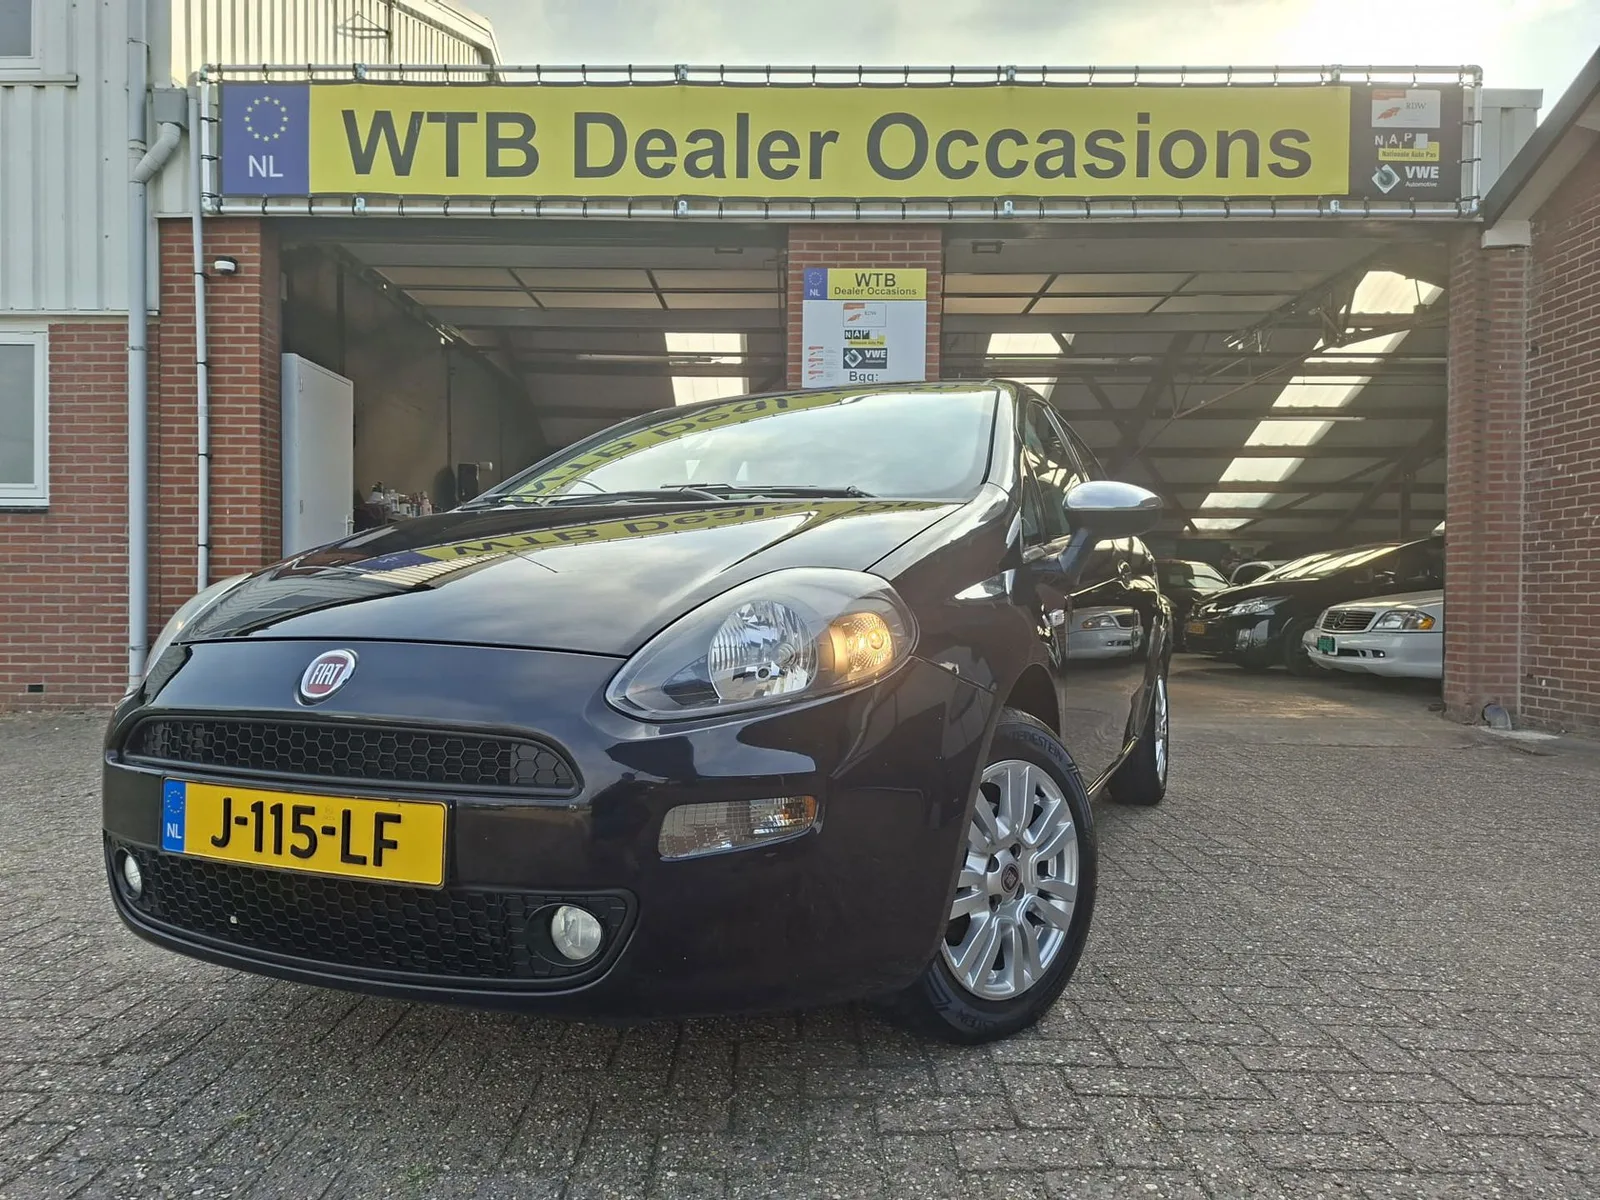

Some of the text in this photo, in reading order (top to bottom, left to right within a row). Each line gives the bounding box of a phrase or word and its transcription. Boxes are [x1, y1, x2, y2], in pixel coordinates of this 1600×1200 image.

[341, 109, 1313, 181] WTB Dealer Occasions
[1381, 150, 1437, 158] Nationale Auto Pas
[247, 154, 284, 179] NL
[1405, 166, 1439, 179] VWE
[855, 272, 896, 287] WTB
[809, 288, 821, 297] NL
[834, 286, 917, 295] Dealer Occasions
[864, 349, 887, 359] VWE
[310, 663, 345, 685] FIAT
[166, 822, 183, 840] NL
[211, 797, 402, 867] J-115-LF
